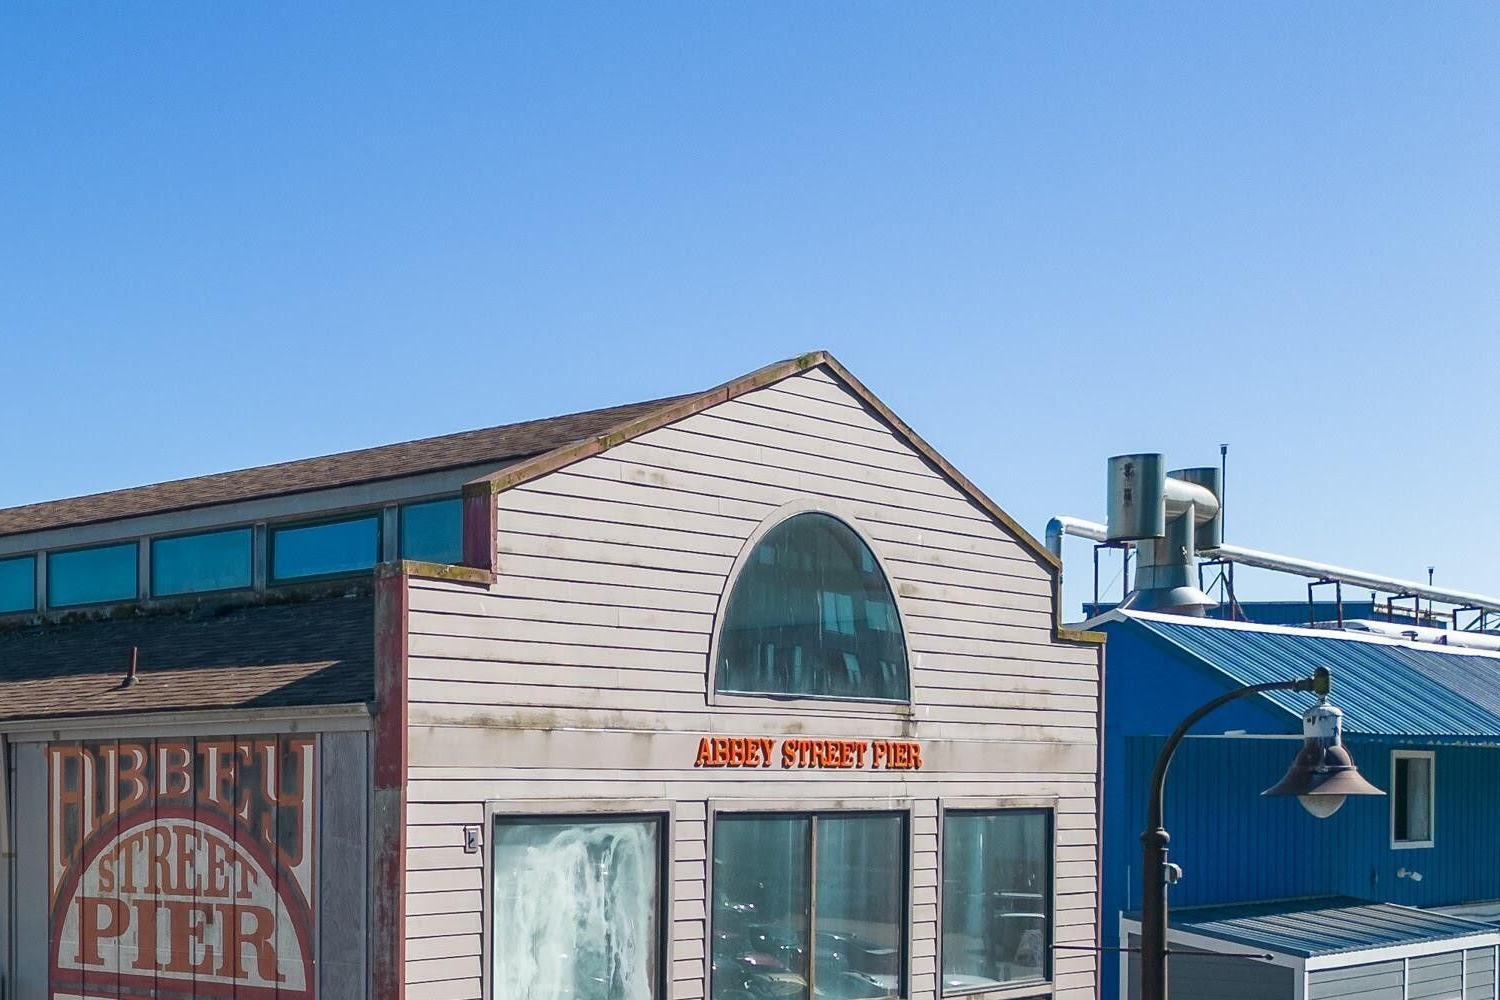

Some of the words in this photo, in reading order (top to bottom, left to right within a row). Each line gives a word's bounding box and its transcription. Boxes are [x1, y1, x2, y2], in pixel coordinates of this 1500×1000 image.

[694, 736, 775, 767] ABBEY
[781, 738, 867, 769] STREET
[872, 740, 922, 769] PIER
[45, 737, 316, 908] ABBEY
[99, 825, 258, 898] STREET
[74, 896, 286, 982] PIER
